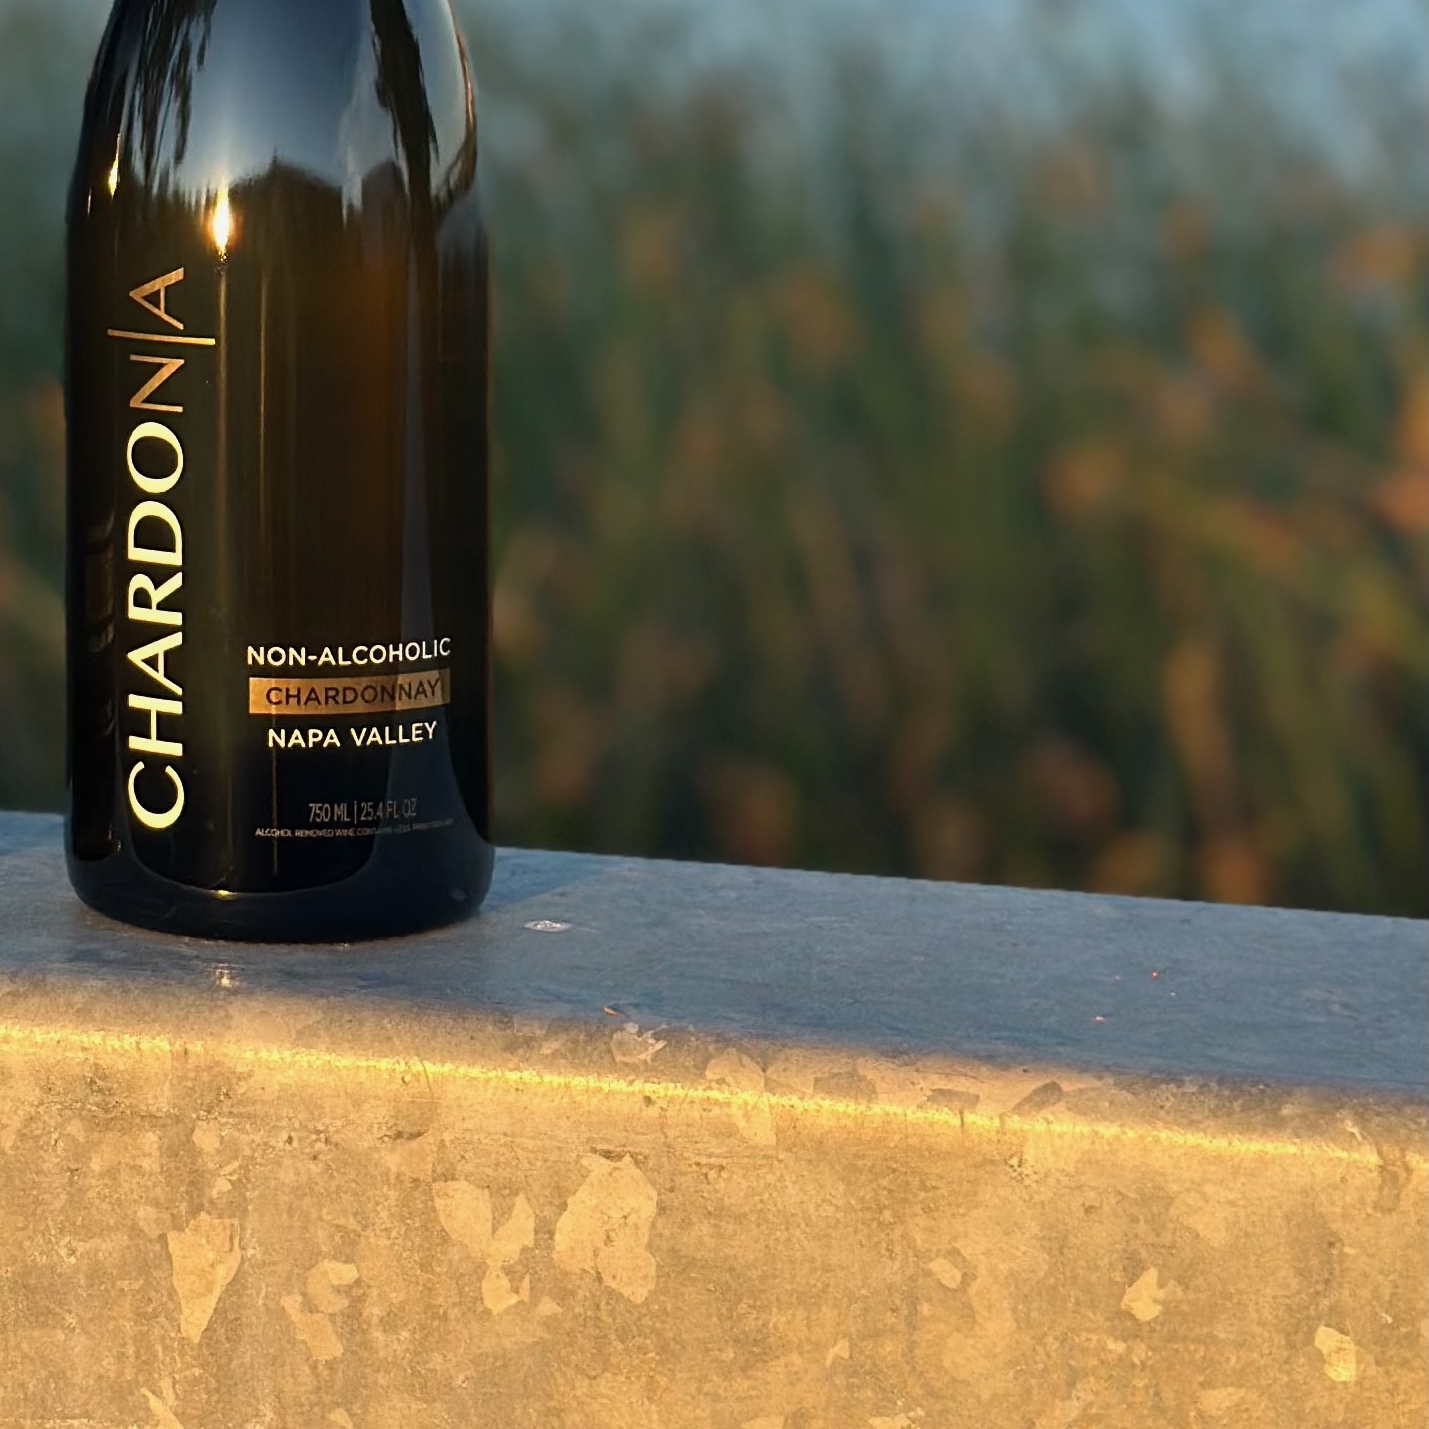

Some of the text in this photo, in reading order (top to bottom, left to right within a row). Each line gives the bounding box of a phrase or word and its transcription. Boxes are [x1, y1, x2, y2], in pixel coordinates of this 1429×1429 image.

[246, 637, 452, 667] NON-ALCOHOLIC
[265, 678, 441, 706] CHARDONNAY
[267, 720, 438, 749] NAPA VALLEY
[308, 803, 331, 822] 750
[333, 802, 351, 822] ML
[360, 802, 383, 821] 25.4
[386, 800, 399, 819] FL
[402, 798, 417, 817] OZ
[255, 828, 294, 837] ALCOHOL
[295, 828, 334, 838] REMOVED
